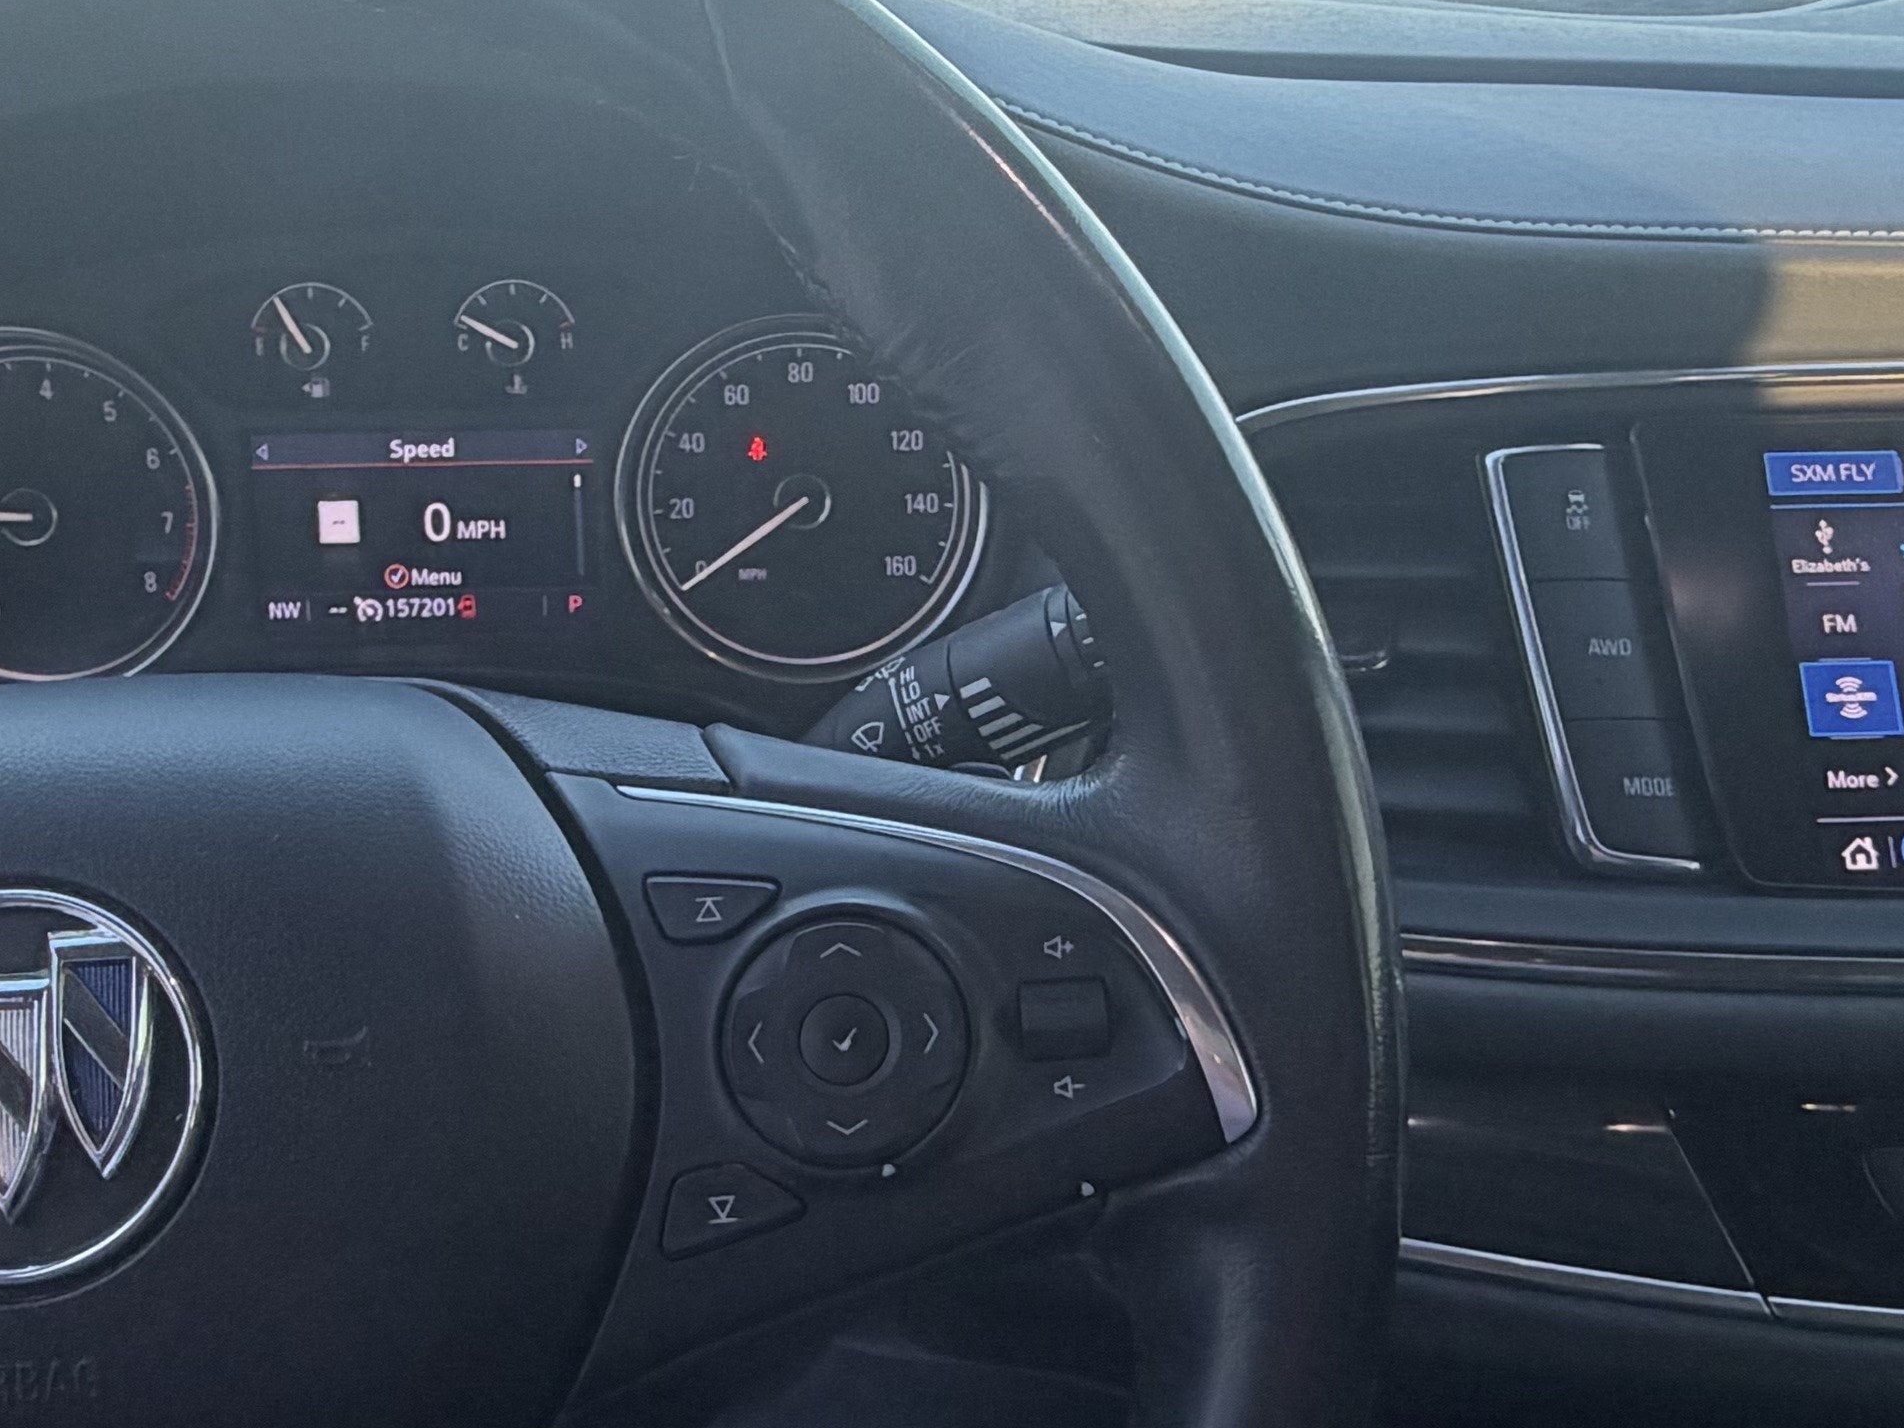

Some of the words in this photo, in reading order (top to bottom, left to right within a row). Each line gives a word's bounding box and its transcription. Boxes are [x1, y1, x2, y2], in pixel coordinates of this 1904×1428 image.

[361, 335, 370, 352] F
[457, 333, 469, 352] C
[560, 332, 574, 350] H
[787, 362, 813, 383] 80
[39, 378, 53, 400] 4
[724, 384, 749, 405] 60
[848, 383, 880, 404] 100
[102, 400, 117, 422] 5
[389, 437, 456, 464] Speed
[678, 432, 705, 453] 40
[891, 430, 924, 452] 120
[145, 447, 160, 469] 6
[1791, 463, 1835, 483] SXM
[1839, 461, 1877, 482] FLY
[669, 497, 694, 519] 20
[904, 492, 939, 514] 140
[161, 511, 173, 534] 7
[423, 502, 452, 542] 0
[456, 520, 506, 540] MPH
[738, 568, 767, 581] MPH
[884, 555, 917, 577] 160
[1791, 556, 1871, 574] Elizabeth's
[144, 571, 157, 593] 8
[411, 568, 462, 587] Menu
[268, 601, 302, 620] NW
[386, 597, 456, 619] 157201
[568, 594, 583, 613] P
[1822, 613, 1858, 634] FM
[1588, 637, 1632, 657] AWD
[900, 666, 915, 684] HI
[900, 682, 921, 703] LO
[905, 699, 933, 724] INT
[912, 716, 942, 744] OFF
[1623, 776, 1675, 797] MODE
[1827, 768, 1880, 789] More
